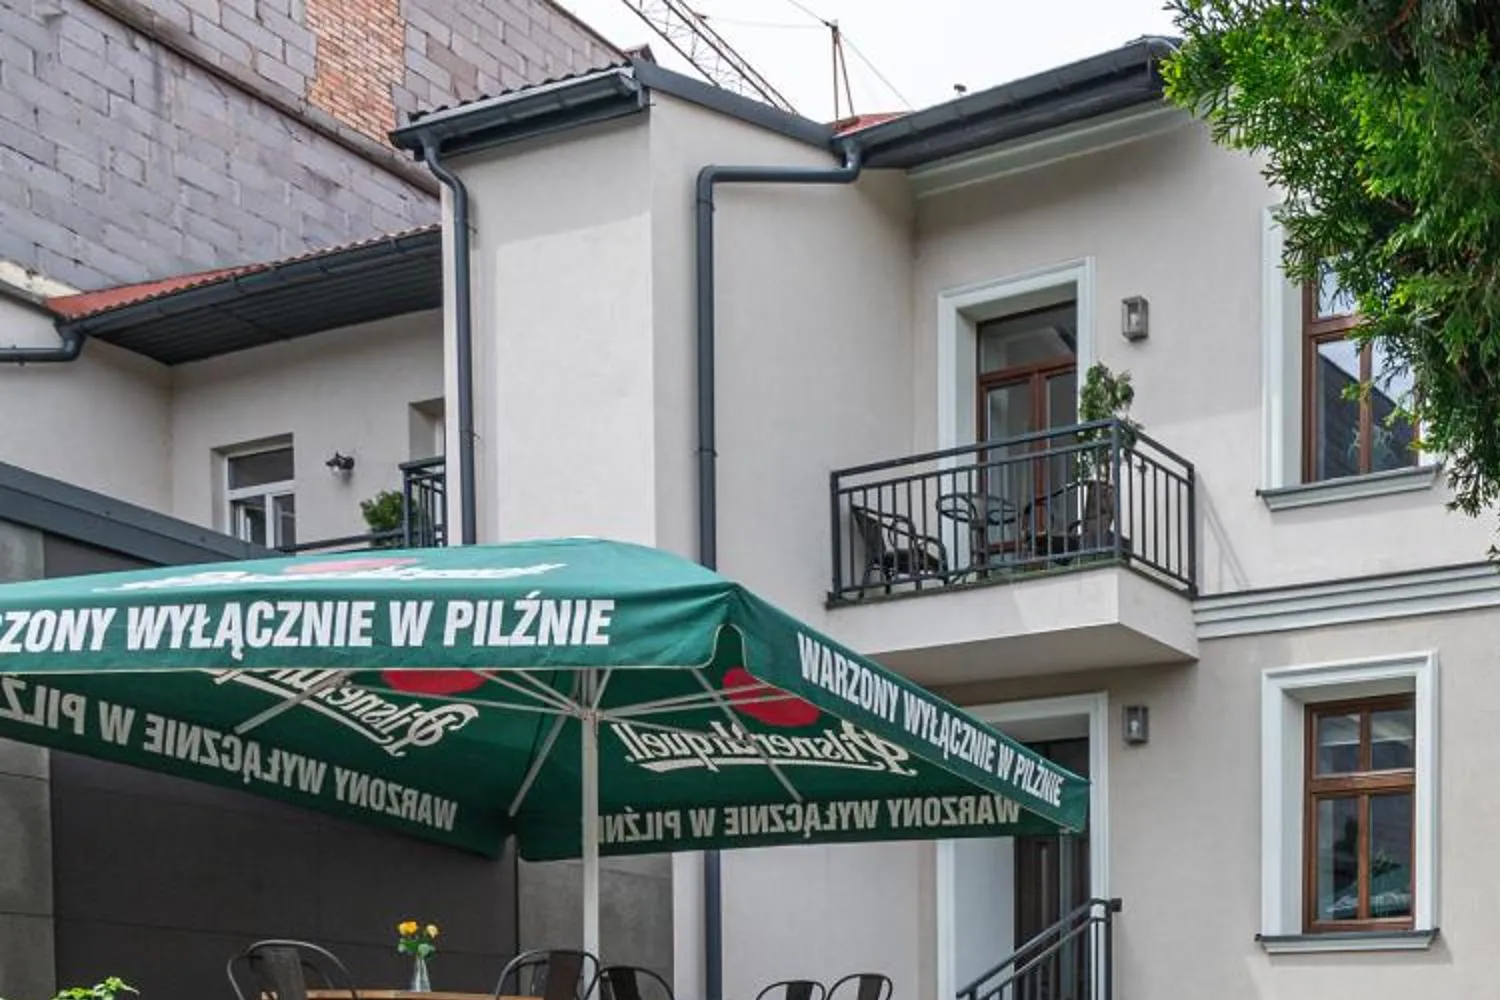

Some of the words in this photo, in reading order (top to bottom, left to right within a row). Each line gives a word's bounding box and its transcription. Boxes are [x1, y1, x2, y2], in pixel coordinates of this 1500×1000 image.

[0, 607, 117, 653] ZONY
[127, 599, 373, 661] WYŁĄCZNIE
[390, 600, 432, 647] W
[443, 590, 616, 647] PILŹNIE
[797, 631, 900, 724] WARZONY
[903, 689, 997, 778] WYŁĄCZNIE
[996, 735, 1015, 782] W
[1013, 754, 1065, 809] PILŹNIE
